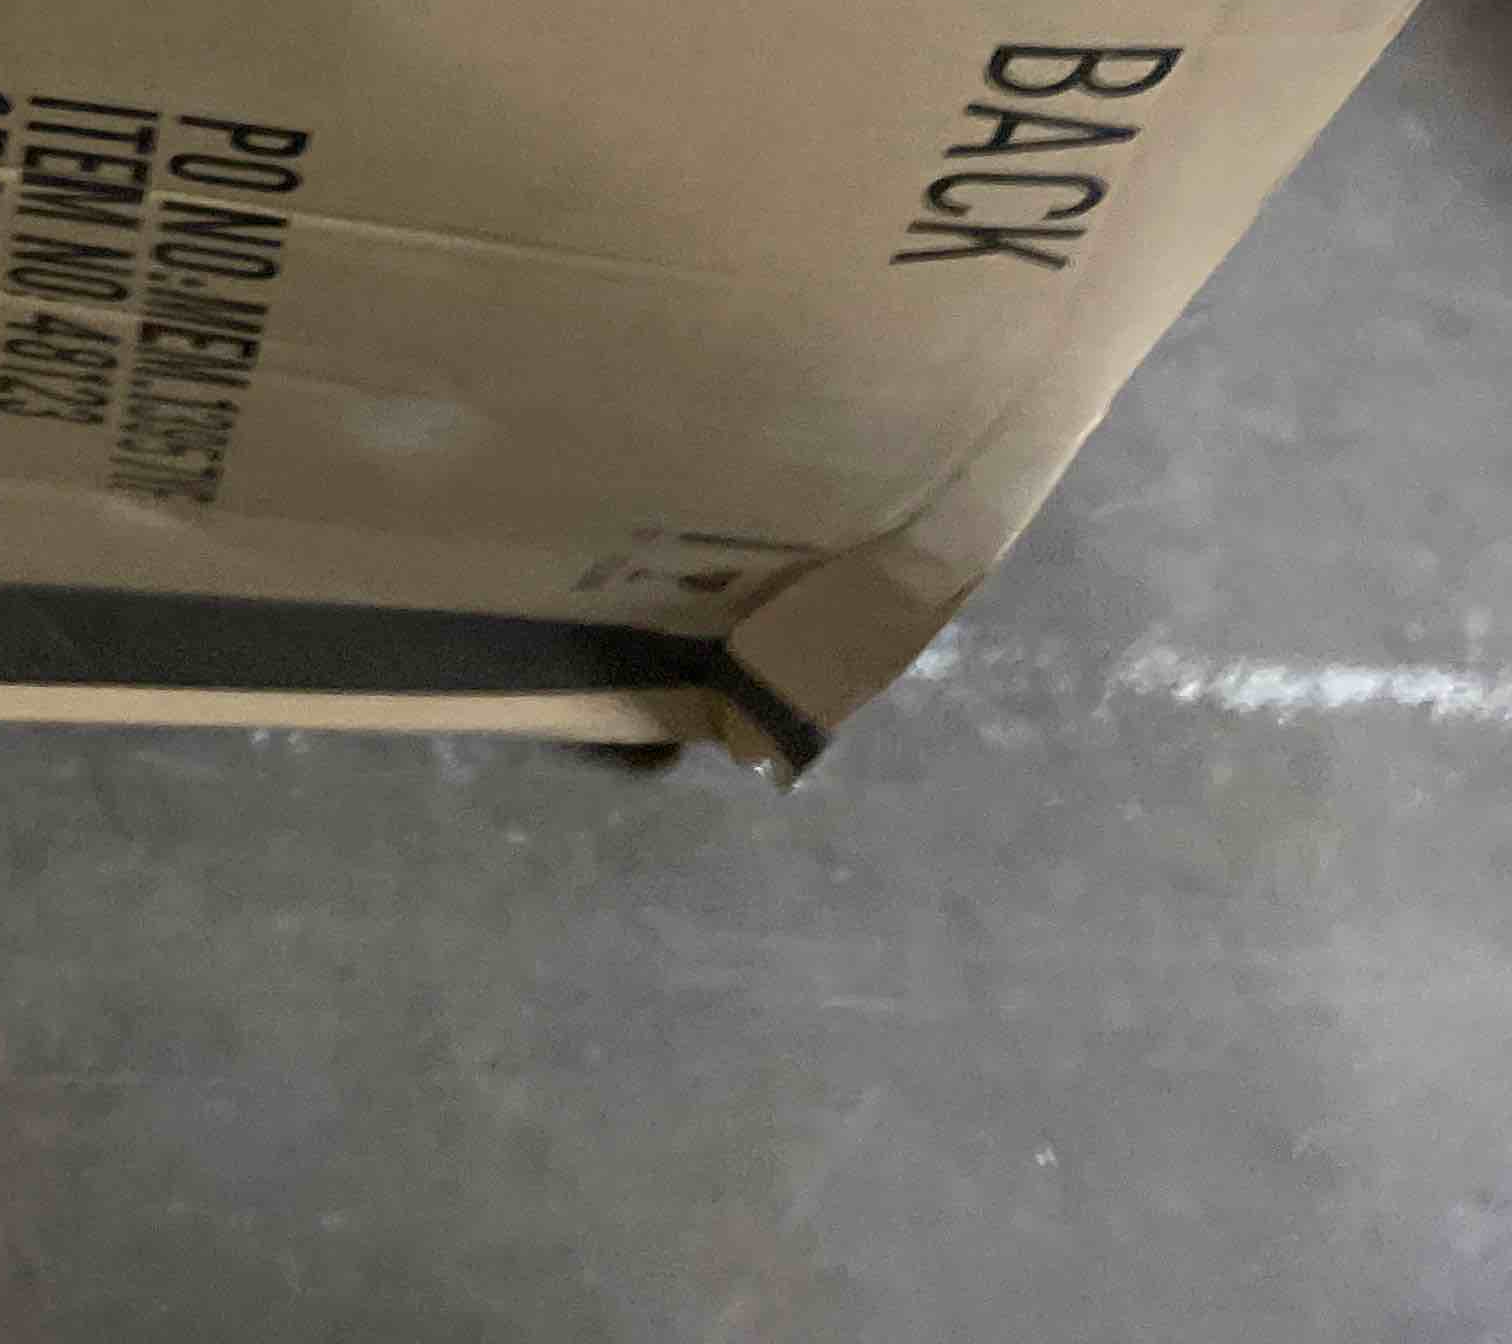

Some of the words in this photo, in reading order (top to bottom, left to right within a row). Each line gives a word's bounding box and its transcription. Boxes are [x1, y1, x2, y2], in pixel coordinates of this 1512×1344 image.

[17, 97, 159, 230] ITEM
[169, 115, 311, 194] PO
[889, 44, 1184, 270] BACK
